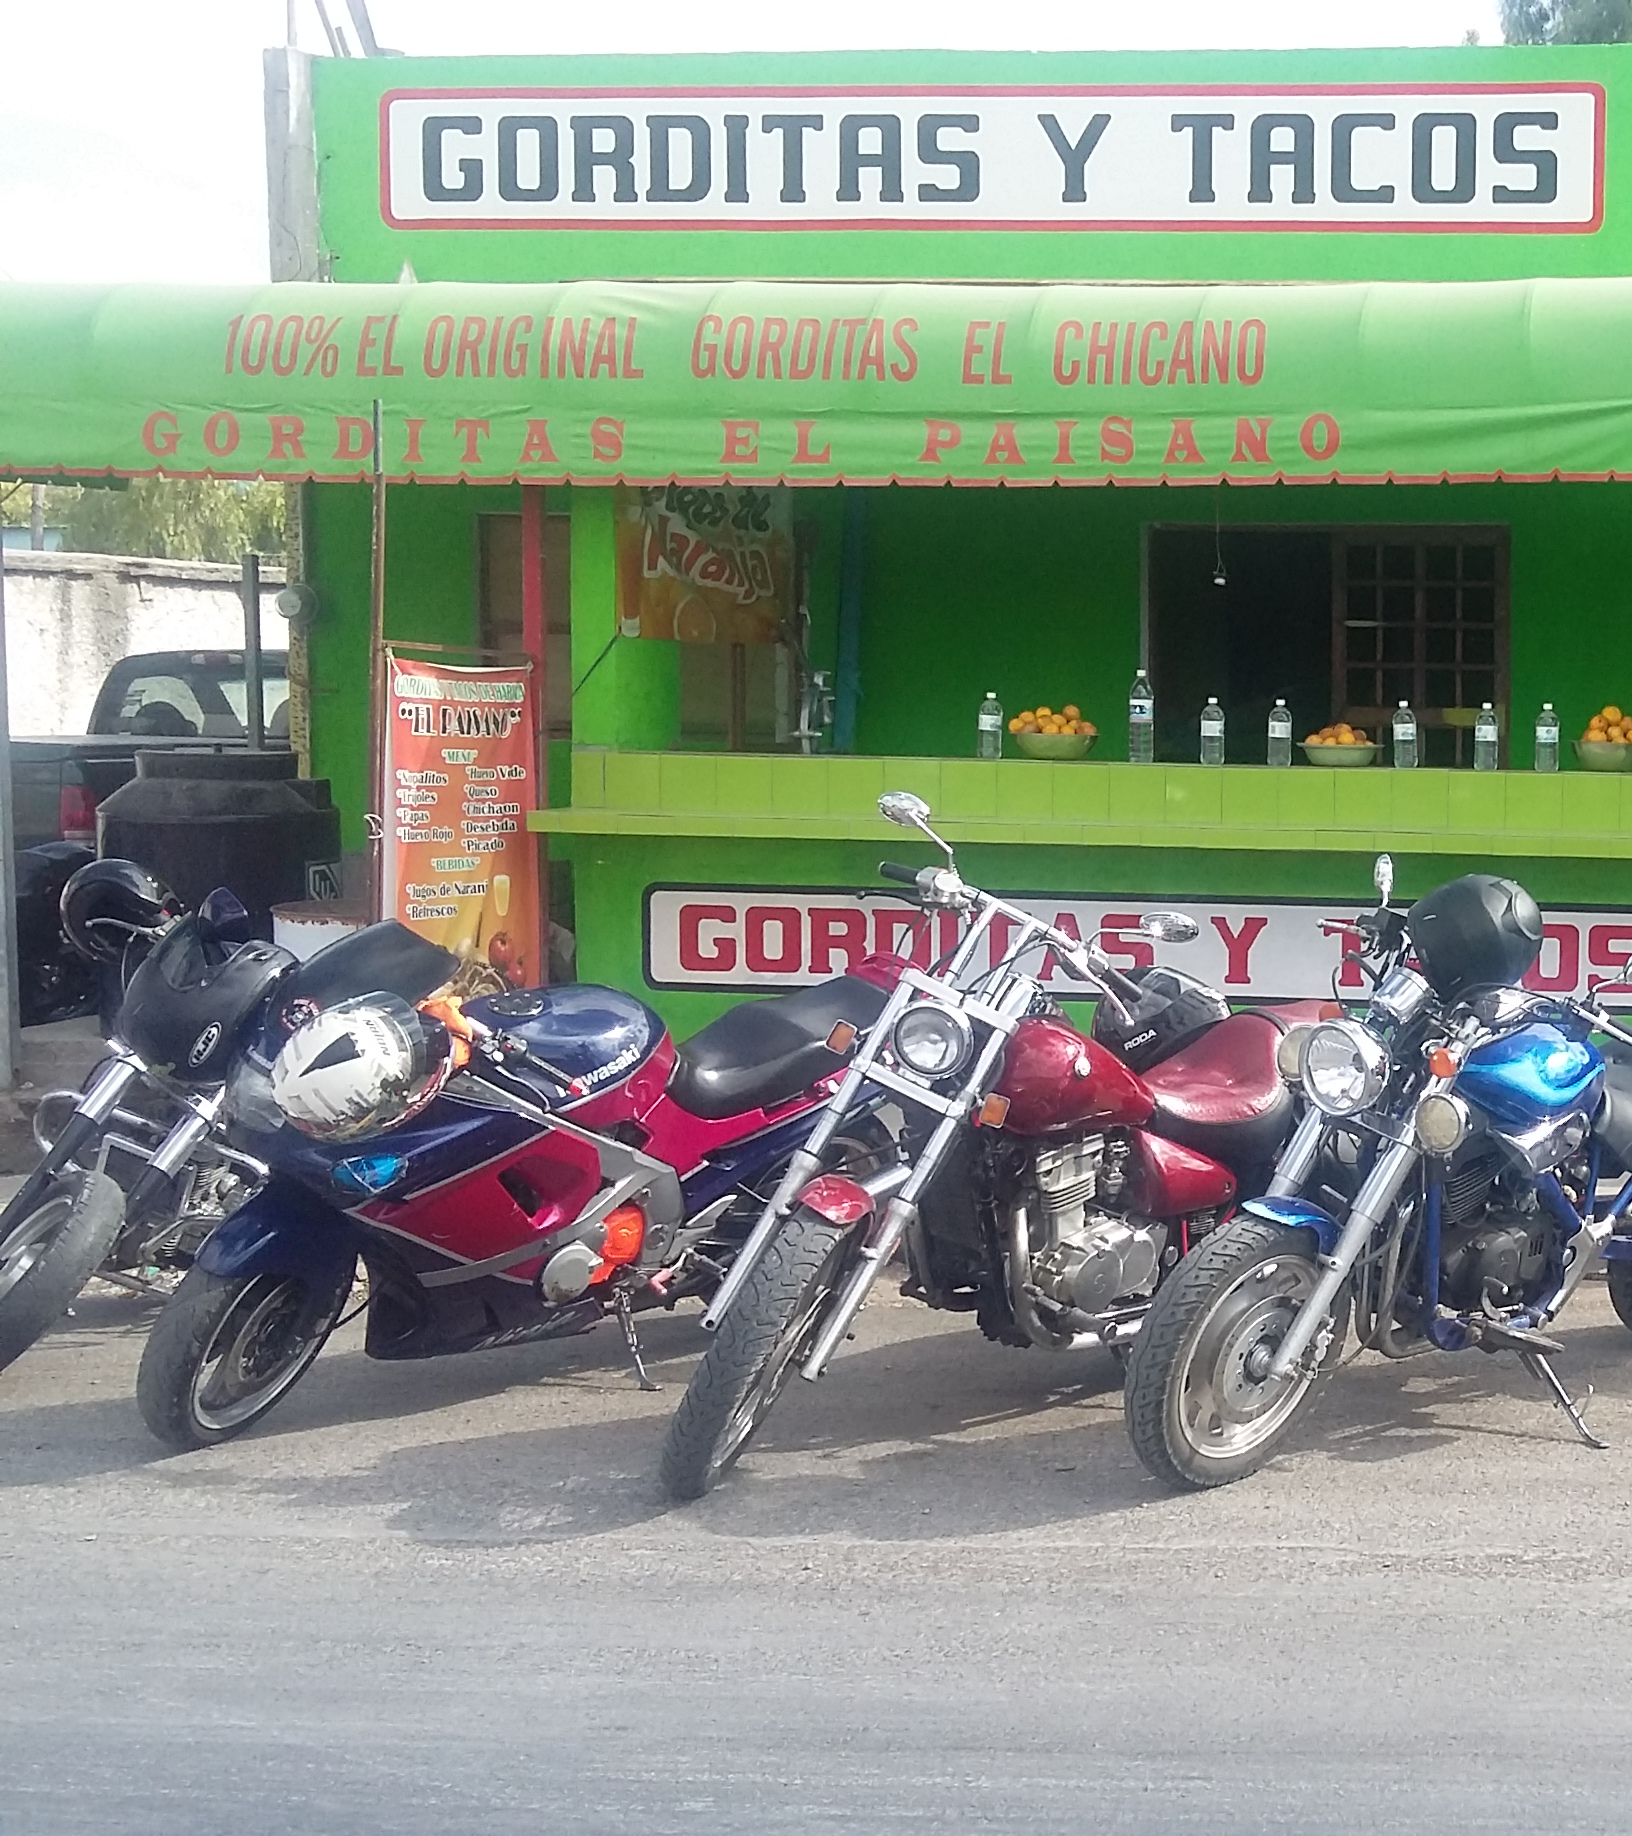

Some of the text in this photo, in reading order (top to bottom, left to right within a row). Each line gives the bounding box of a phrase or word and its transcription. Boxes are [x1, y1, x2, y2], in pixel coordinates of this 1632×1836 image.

[421, 111, 1559, 204] GORDITAS Y TACOS
[223, 313, 1266, 388] 100% EL ORIGINAL GORDITAS EL CHICANO
[141, 411, 1342, 465] GORDITAS EL PAISANO
[1211, 916, 1268, 986] Y
[555, 1043, 641, 1098] wasaki
[1123, 1028, 1157, 1051] RODA
